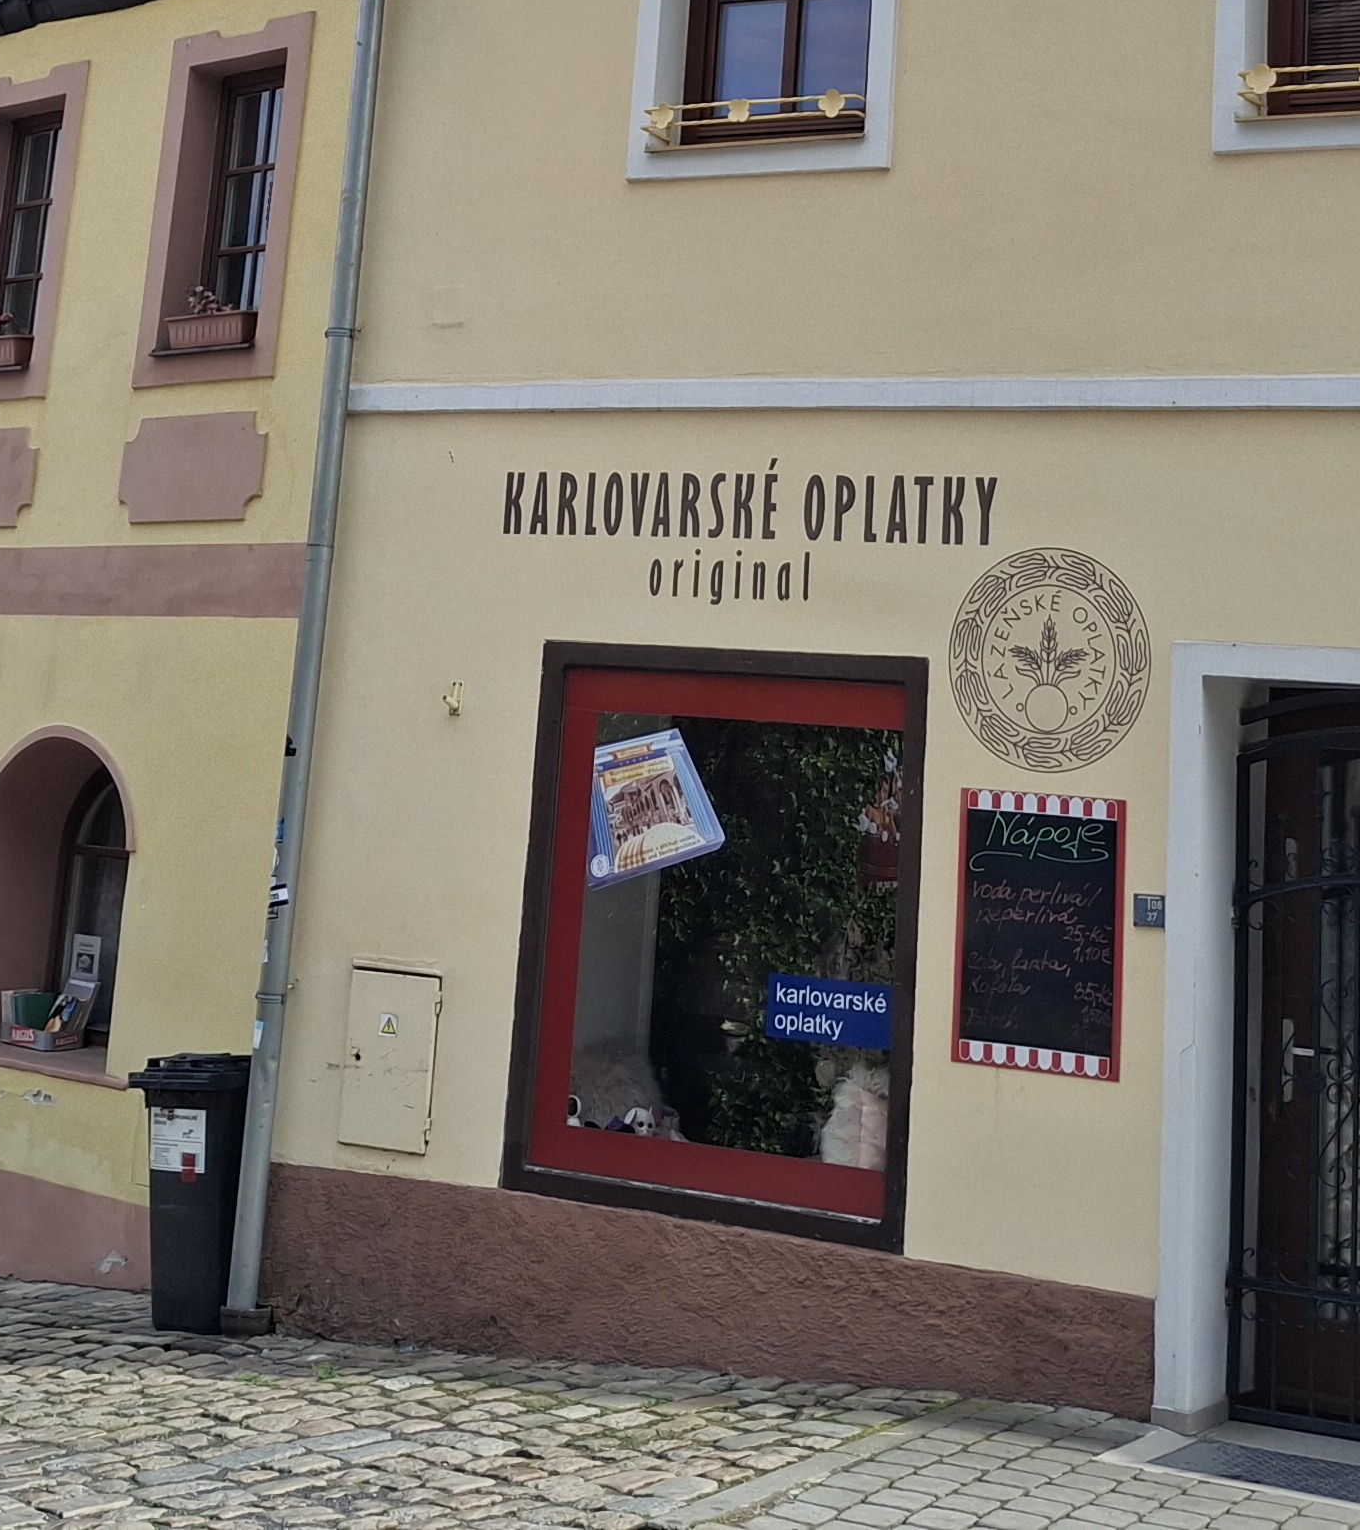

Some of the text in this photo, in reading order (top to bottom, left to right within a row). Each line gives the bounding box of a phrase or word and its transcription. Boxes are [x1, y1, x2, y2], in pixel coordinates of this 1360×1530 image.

[502, 457, 998, 546] KARLOVARSKÉ OPLATKY
[649, 548, 812, 605] original
[987, 590, 1107, 711] LÁZEŇSKÉ OPLATKY
[985, 811, 1106, 860] Nápoje
[972, 878, 1017, 901] voda
[775, 981, 887, 1014] karlovarské
[774, 1011, 844, 1041] oplatky
